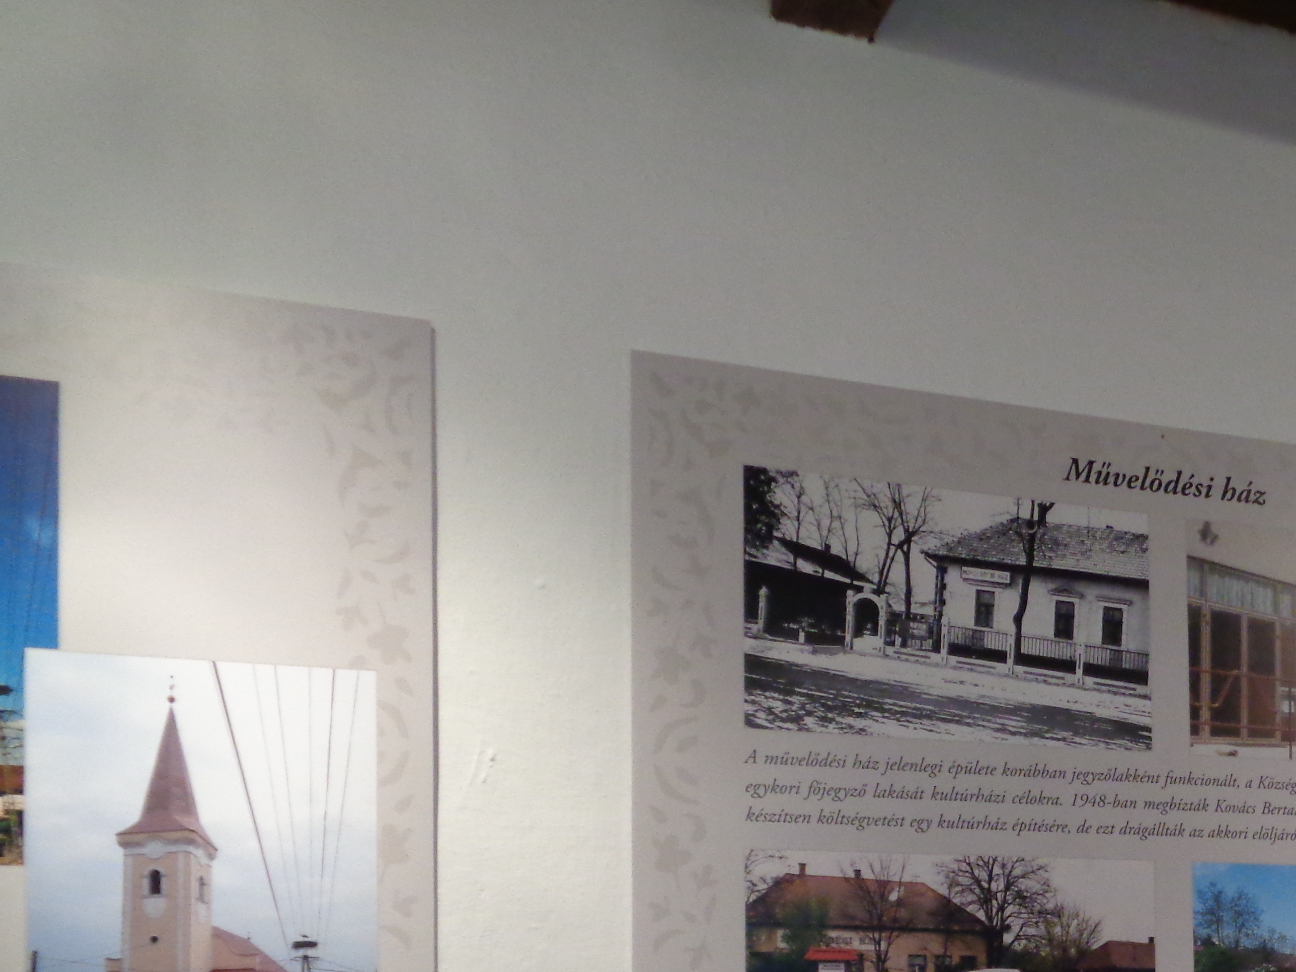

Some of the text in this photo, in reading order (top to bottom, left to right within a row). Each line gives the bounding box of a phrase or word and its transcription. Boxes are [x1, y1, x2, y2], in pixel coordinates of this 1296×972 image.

[1063, 456, 1267, 506] Művelődési ház
[744, 749, 757, 764] A
[764, 751, 848, 769] művelődési
[852, 753, 880, 771] ház
[880, 756, 943, 778] jelenlegi
[948, 760, 997, 779] épülete
[1001, 762, 1067, 780] korábban
[1068, 766, 1161, 785] jegyzőlakként
[1161, 770, 1240, 789] funkcionált,
[1244, 779, 1252, 789] a
[745, 778, 802, 799] egykori
[803, 780, 868, 802] főjegyző
[872, 782, 925, 800] lakását
[930, 786, 1006, 805] kultúrházi
[1011, 790, 1063, 806] célokra.
[1071, 793, 1137, 809] 1948-ban
[1143, 796, 1210, 815] megbízták
[1214, 799, 1257, 814] Kovács
[745, 806, 812, 825] készítsen
[816, 809, 906, 831] költségvetést
[910, 817, 933, 833] egy
[937, 814, 1007, 831] kultúrház
[1012, 817, 1071, 836] építésére,
[1076, 819, 1092, 834] de
[1096, 824, 1116, 835] ezt
[1119, 820, 1186, 840] drágállták
[1188, 828, 1204, 839] az
[1208, 824, 1249, 840] akkori
